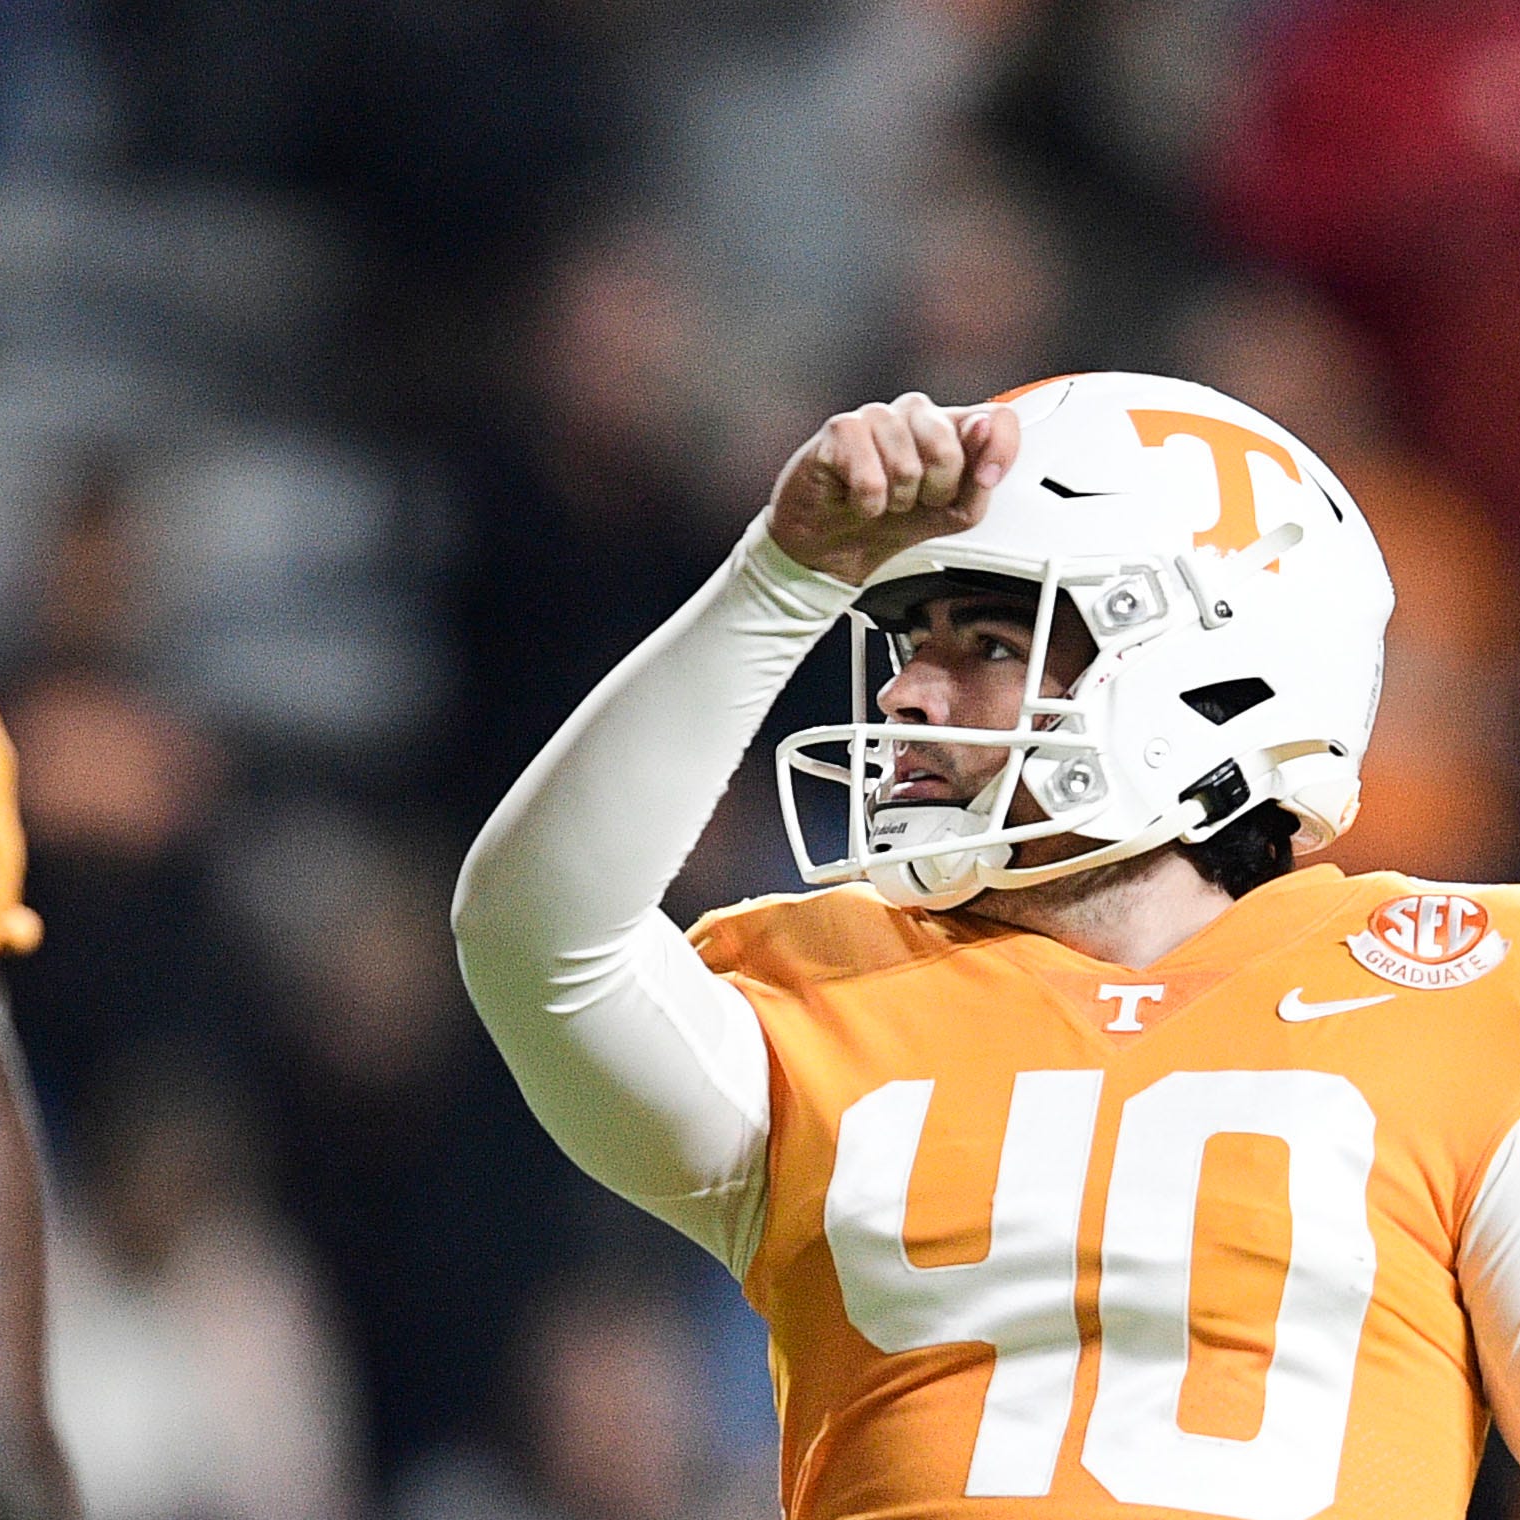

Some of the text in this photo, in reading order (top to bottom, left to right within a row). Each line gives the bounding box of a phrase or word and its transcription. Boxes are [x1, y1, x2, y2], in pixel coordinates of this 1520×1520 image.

[1127, 409, 1302, 574] T
[1383, 895, 1480, 958] SEC
[1365, 949, 1488, 985] GRADUATE
[1098, 983, 1163, 1032] T
